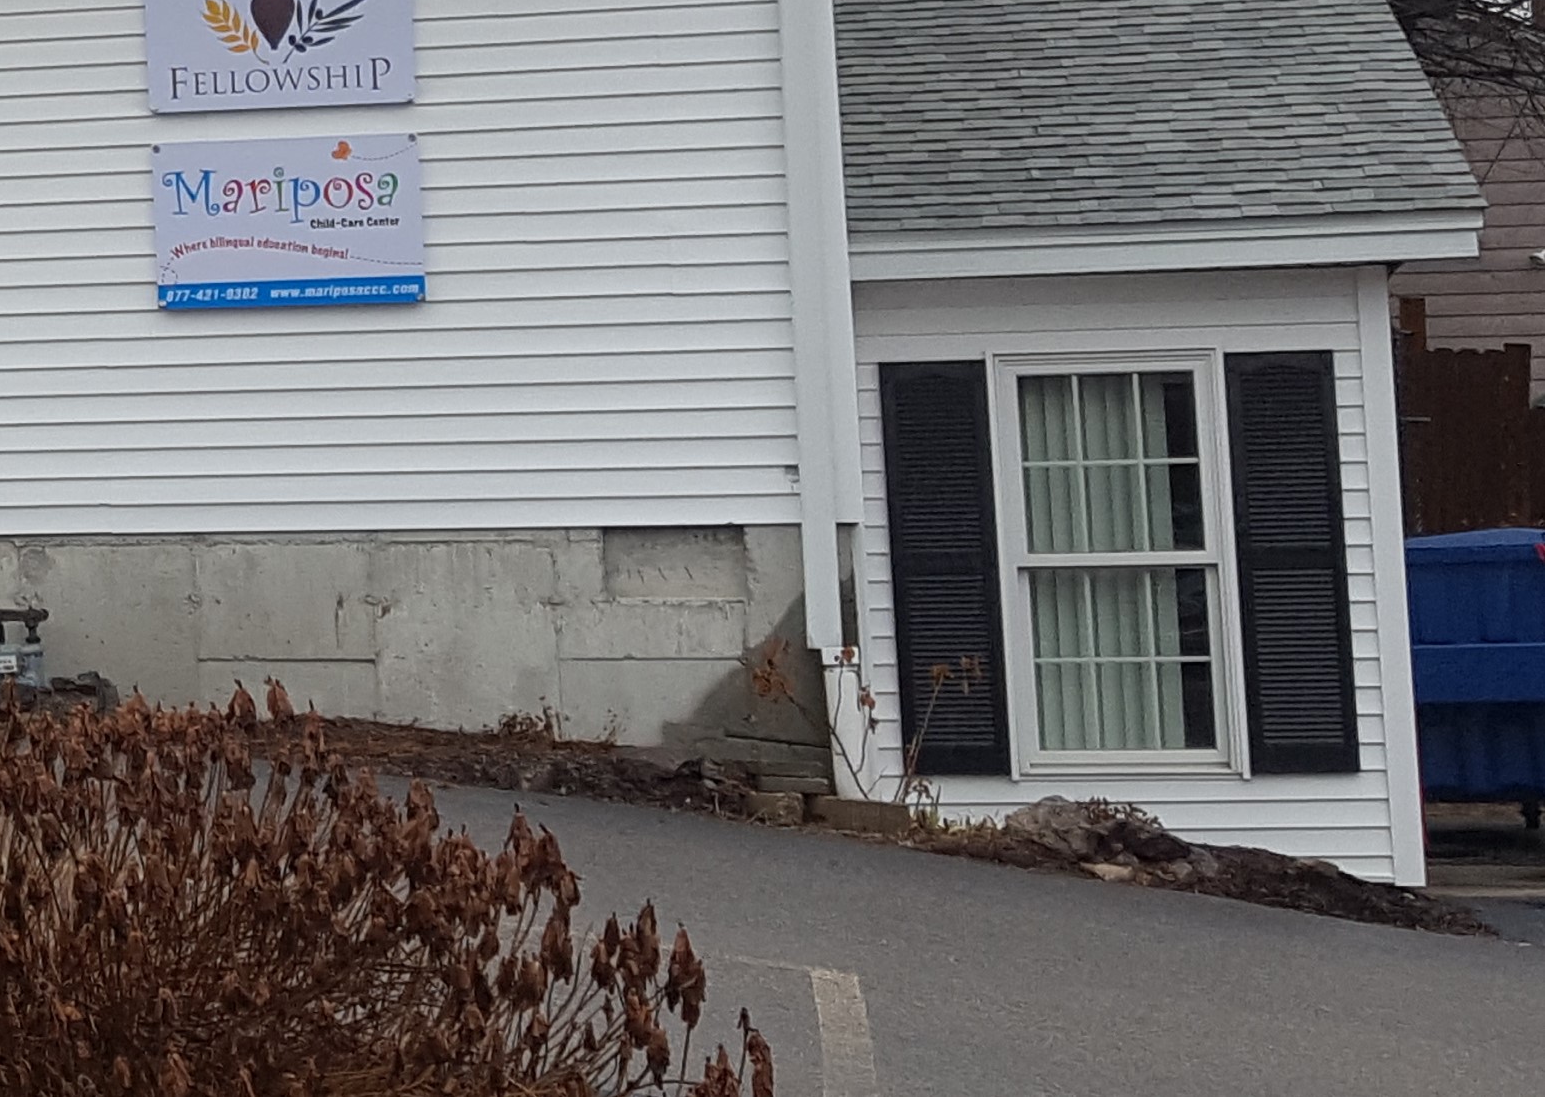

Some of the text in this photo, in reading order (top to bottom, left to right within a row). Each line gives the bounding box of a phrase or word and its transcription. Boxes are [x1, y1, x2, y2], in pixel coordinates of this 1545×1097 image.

[170, 57, 391, 100] FELLOWSHIP
[162, 166, 399, 224] Mariposa
[310, 216, 400, 229] Child-Care Center
[171, 236, 349, 259] Where bilingual education begins!
[270, 283, 419, 299] www.mariposaccc.com
